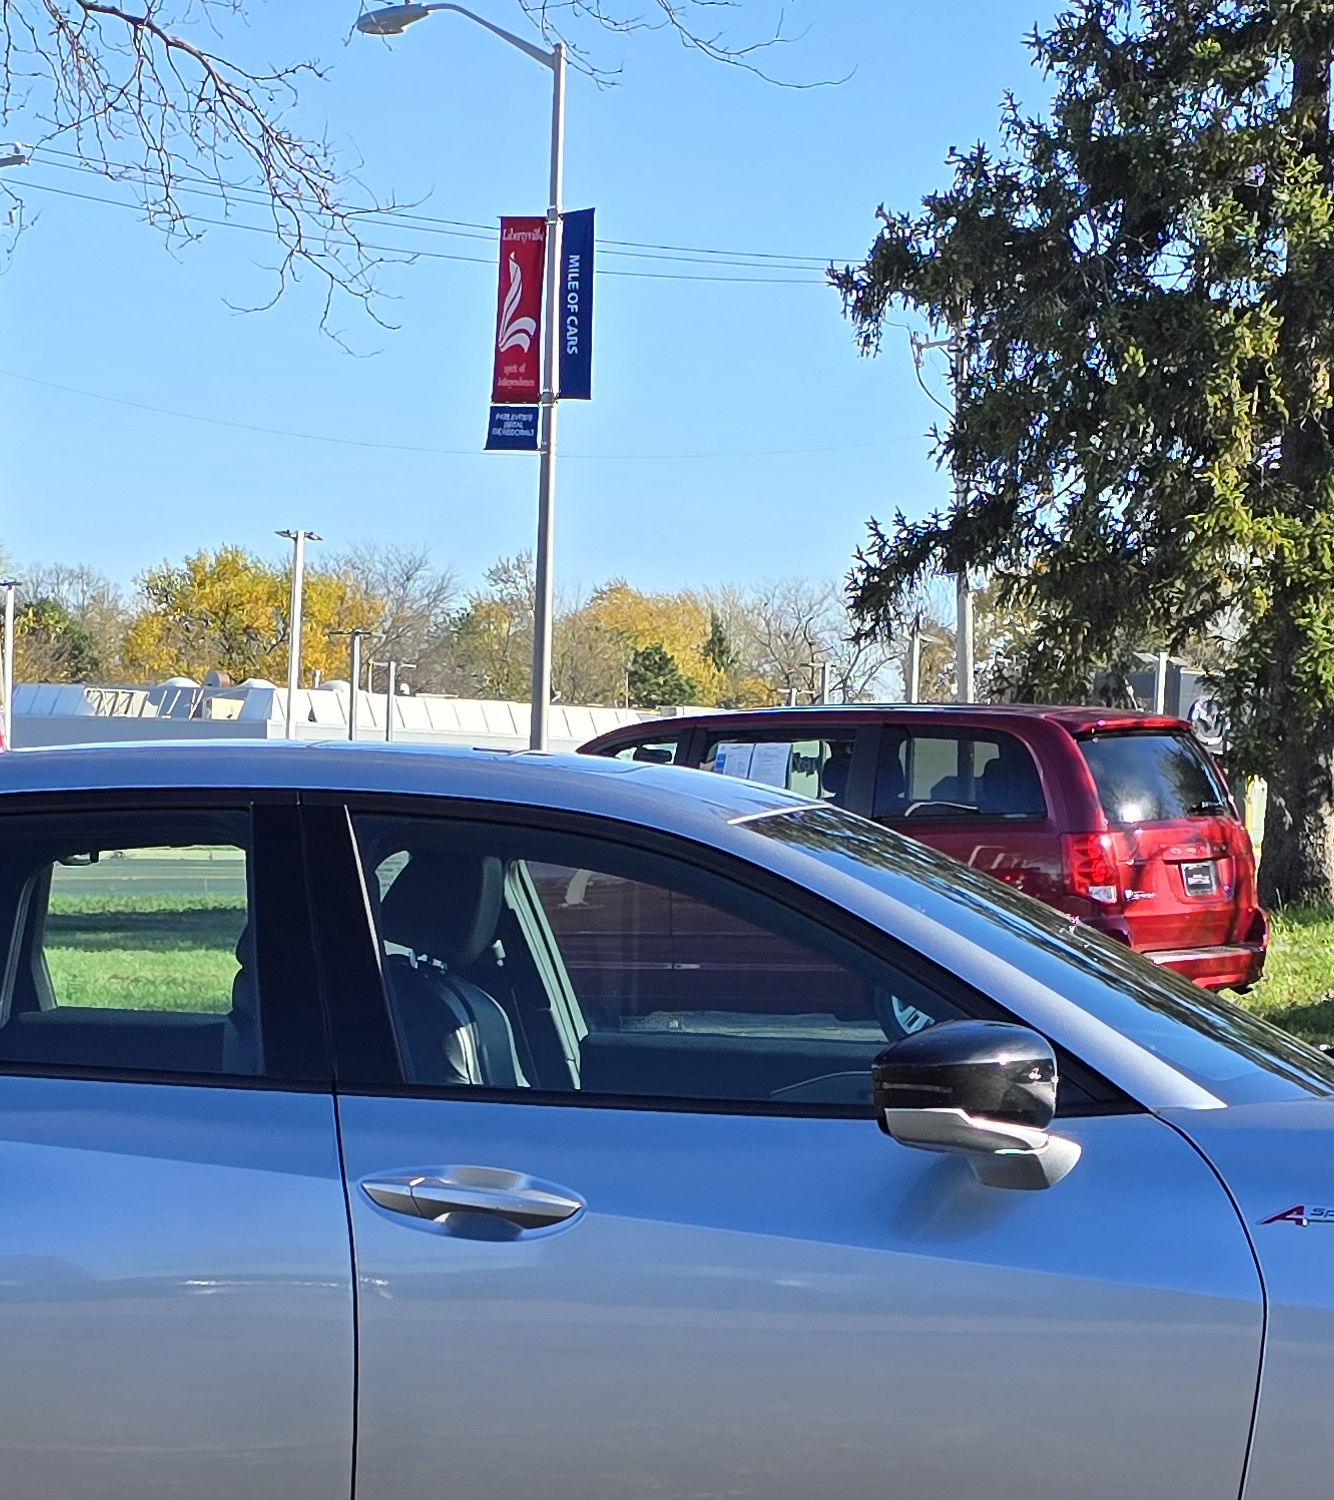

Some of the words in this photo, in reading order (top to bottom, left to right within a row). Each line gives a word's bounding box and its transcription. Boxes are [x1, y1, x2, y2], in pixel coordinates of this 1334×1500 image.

[567, 254, 581, 291] MILE
[567, 292, 579, 314] OF
[566, 315, 579, 355] CARS
